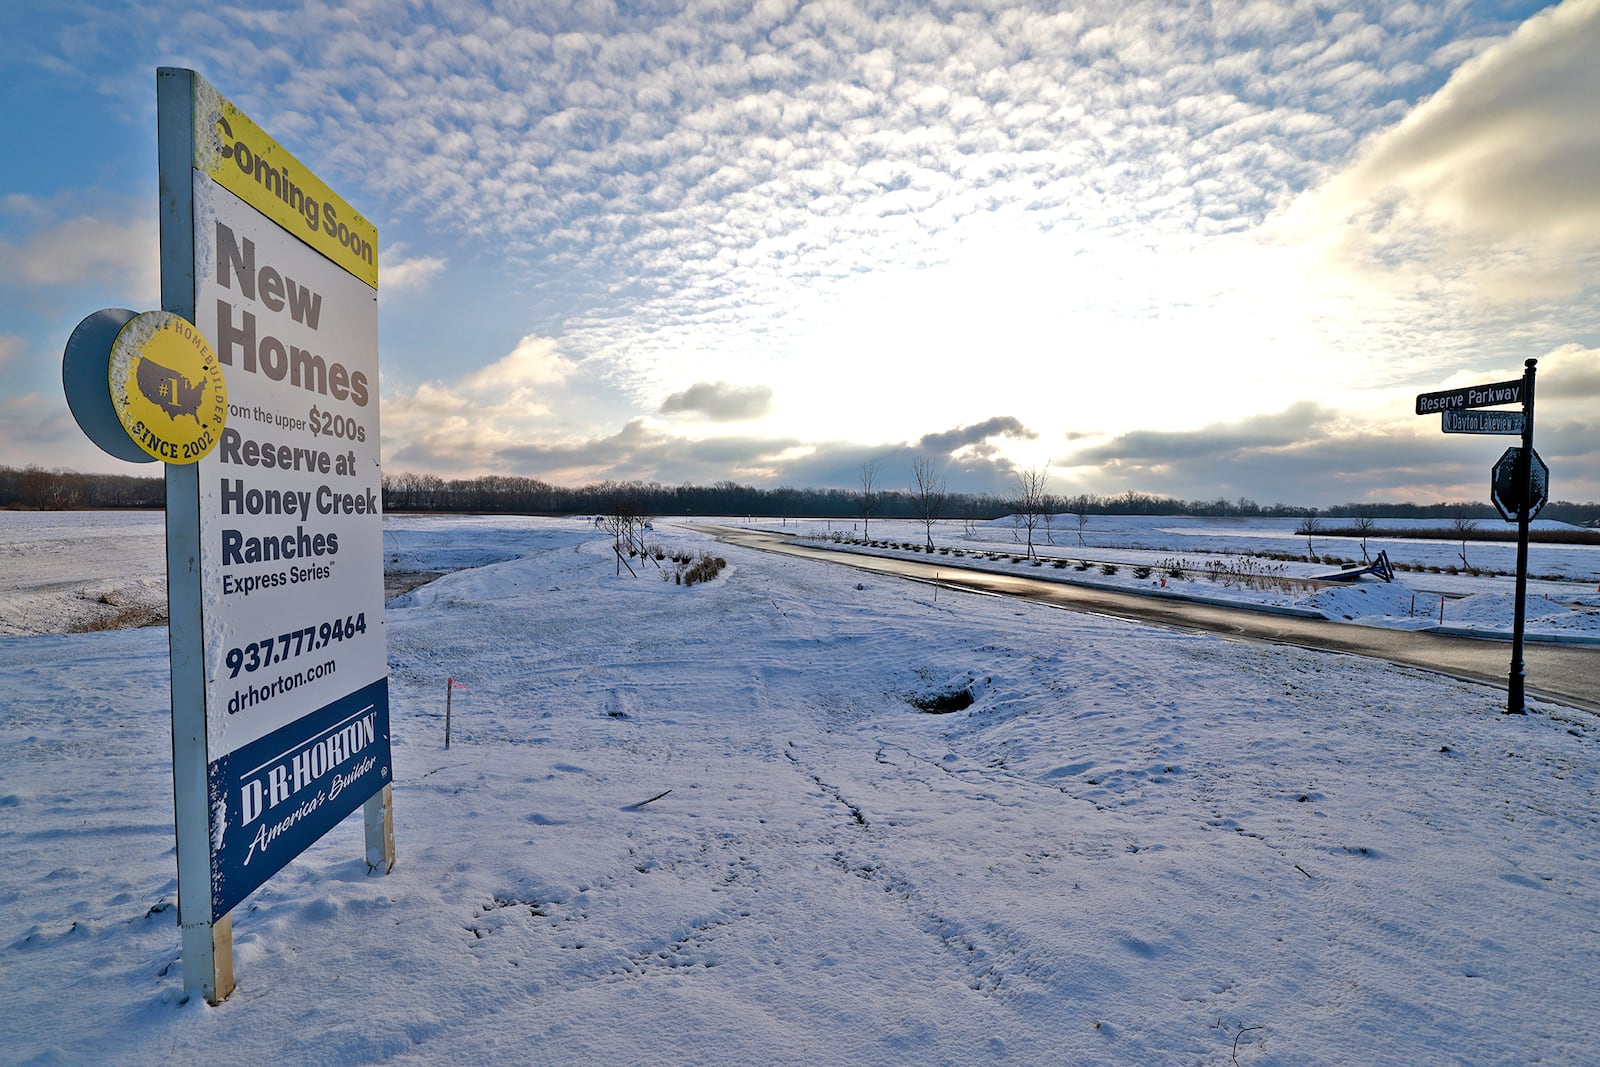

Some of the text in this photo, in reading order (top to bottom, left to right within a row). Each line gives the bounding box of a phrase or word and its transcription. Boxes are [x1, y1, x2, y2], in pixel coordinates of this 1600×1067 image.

[208, 111, 372, 266] Coming Soon
[216, 223, 322, 331] New
[175, 321, 224, 424] HOMEBUILDER
[217, 299, 369, 407] Homes
[159, 377, 182, 407] #1
[1420, 386, 1520, 411] Reserve Parkway
[132, 420, 214, 459] SINCE 2002
[253, 406, 273, 424] the
[275, 414, 307, 431] upper
[309, 404, 366, 443] $200s
[1452, 413, 1478, 431] Dayton
[220, 427, 356, 477] Reserve at
[221, 478, 378, 522] Honey Creek
[222, 526, 339, 566] Ranches
[223, 571, 287, 596] Express
[225, 612, 367, 680] 937.777.9464
[227, 659, 336, 715] drhorton.com
[243, 755, 377, 866] America's Builder
